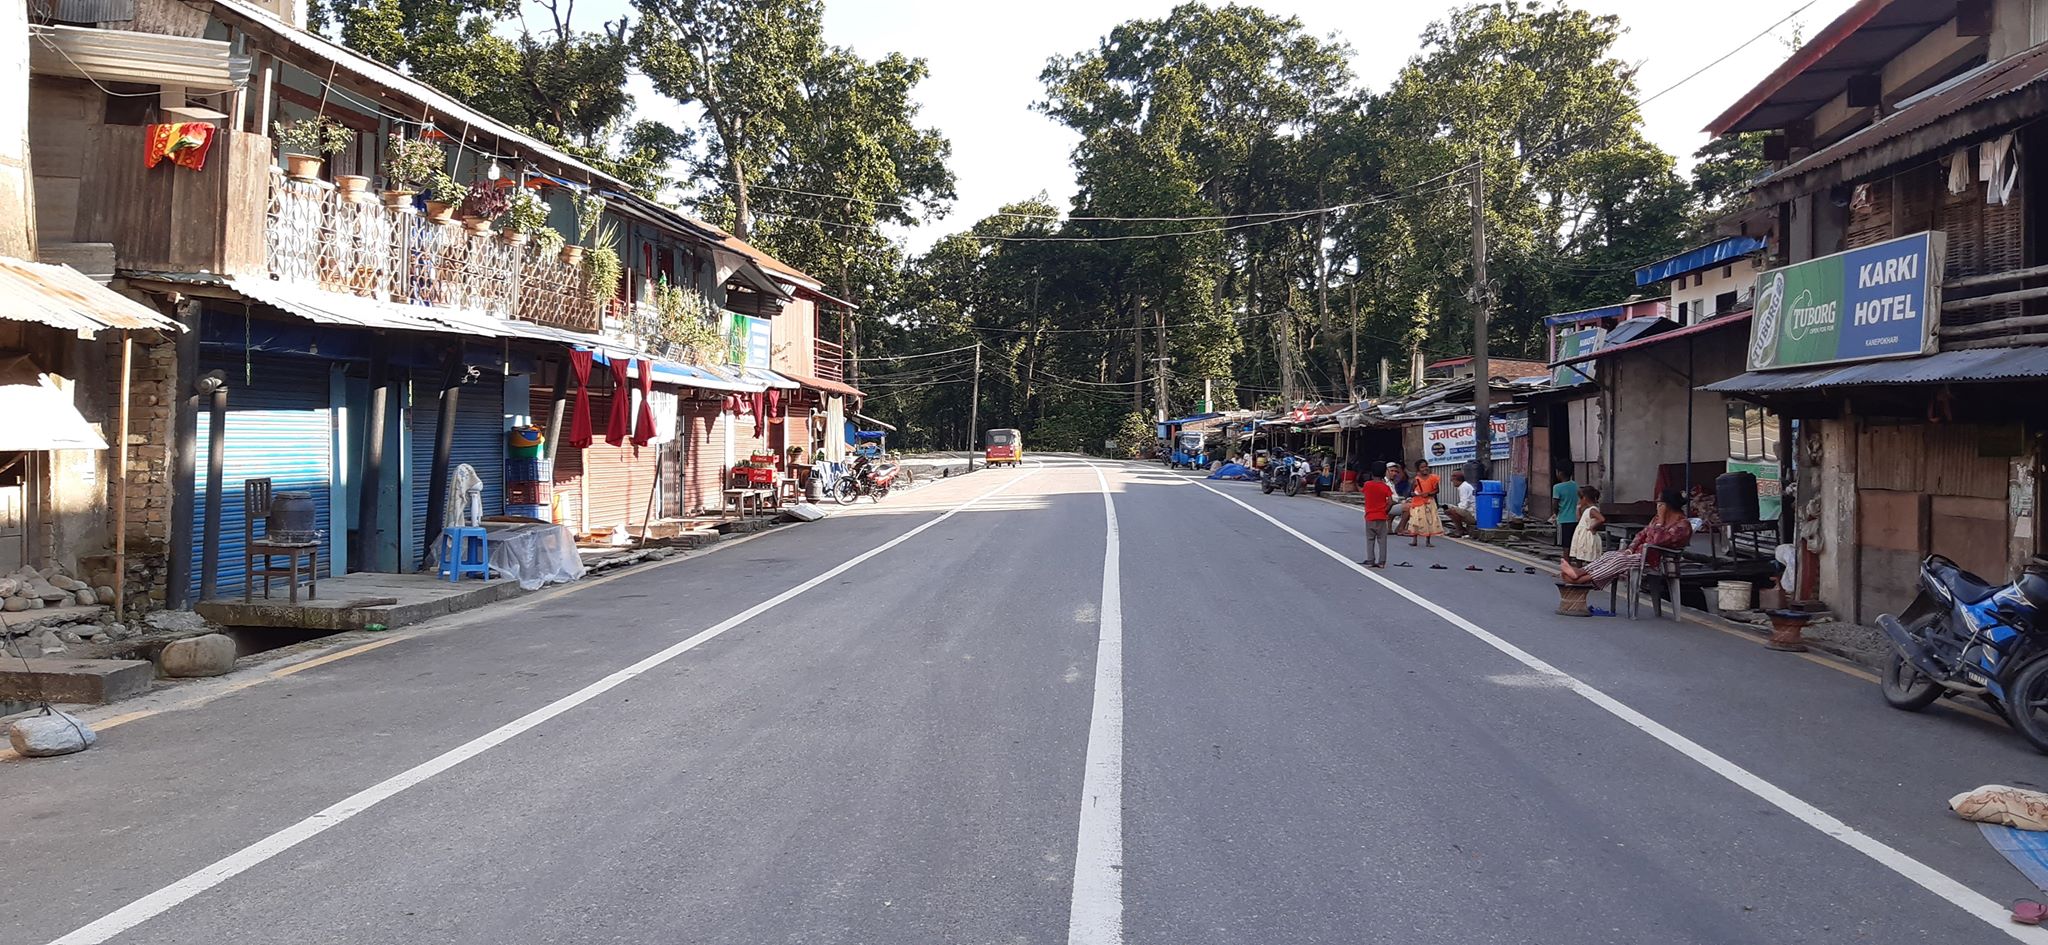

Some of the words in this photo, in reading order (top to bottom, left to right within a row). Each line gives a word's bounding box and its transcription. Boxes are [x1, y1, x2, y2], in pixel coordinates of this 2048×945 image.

[1858, 254, 1918, 289] KARKI
[1752, 294, 1780, 359] TUBORG
[1793, 301, 1836, 330] TUBORG
[1854, 294, 1916, 327] HOTEL
[1429, 426, 1474, 440] जगदम्ब
